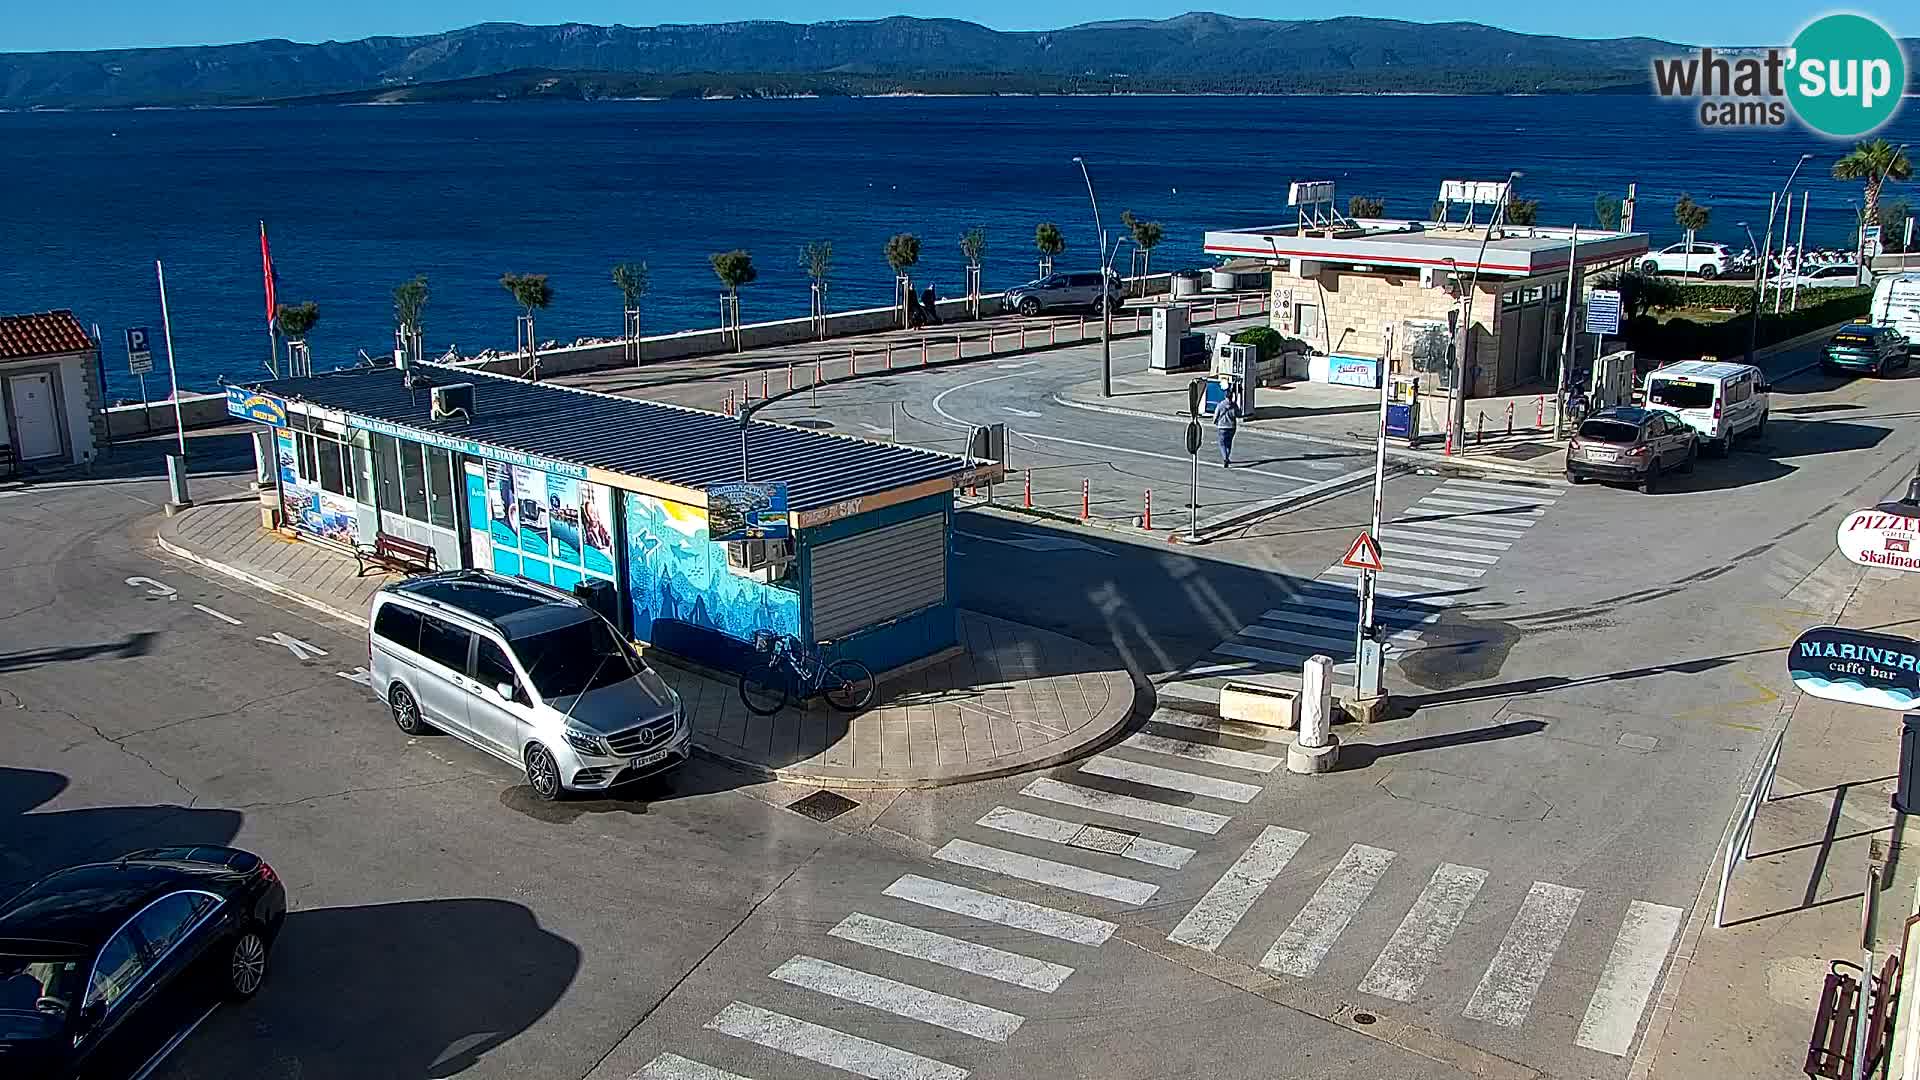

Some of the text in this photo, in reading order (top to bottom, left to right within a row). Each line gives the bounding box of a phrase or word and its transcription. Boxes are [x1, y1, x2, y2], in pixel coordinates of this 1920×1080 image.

[131, 331, 144, 349] P
[494, 449, 527, 464] STATION
[528, 456, 555, 470] TICKET
[556, 463, 584, 476] OFFICE
[1881, 531, 1917, 541] GRILL
[1829, 662, 1897, 680] caffe bar
